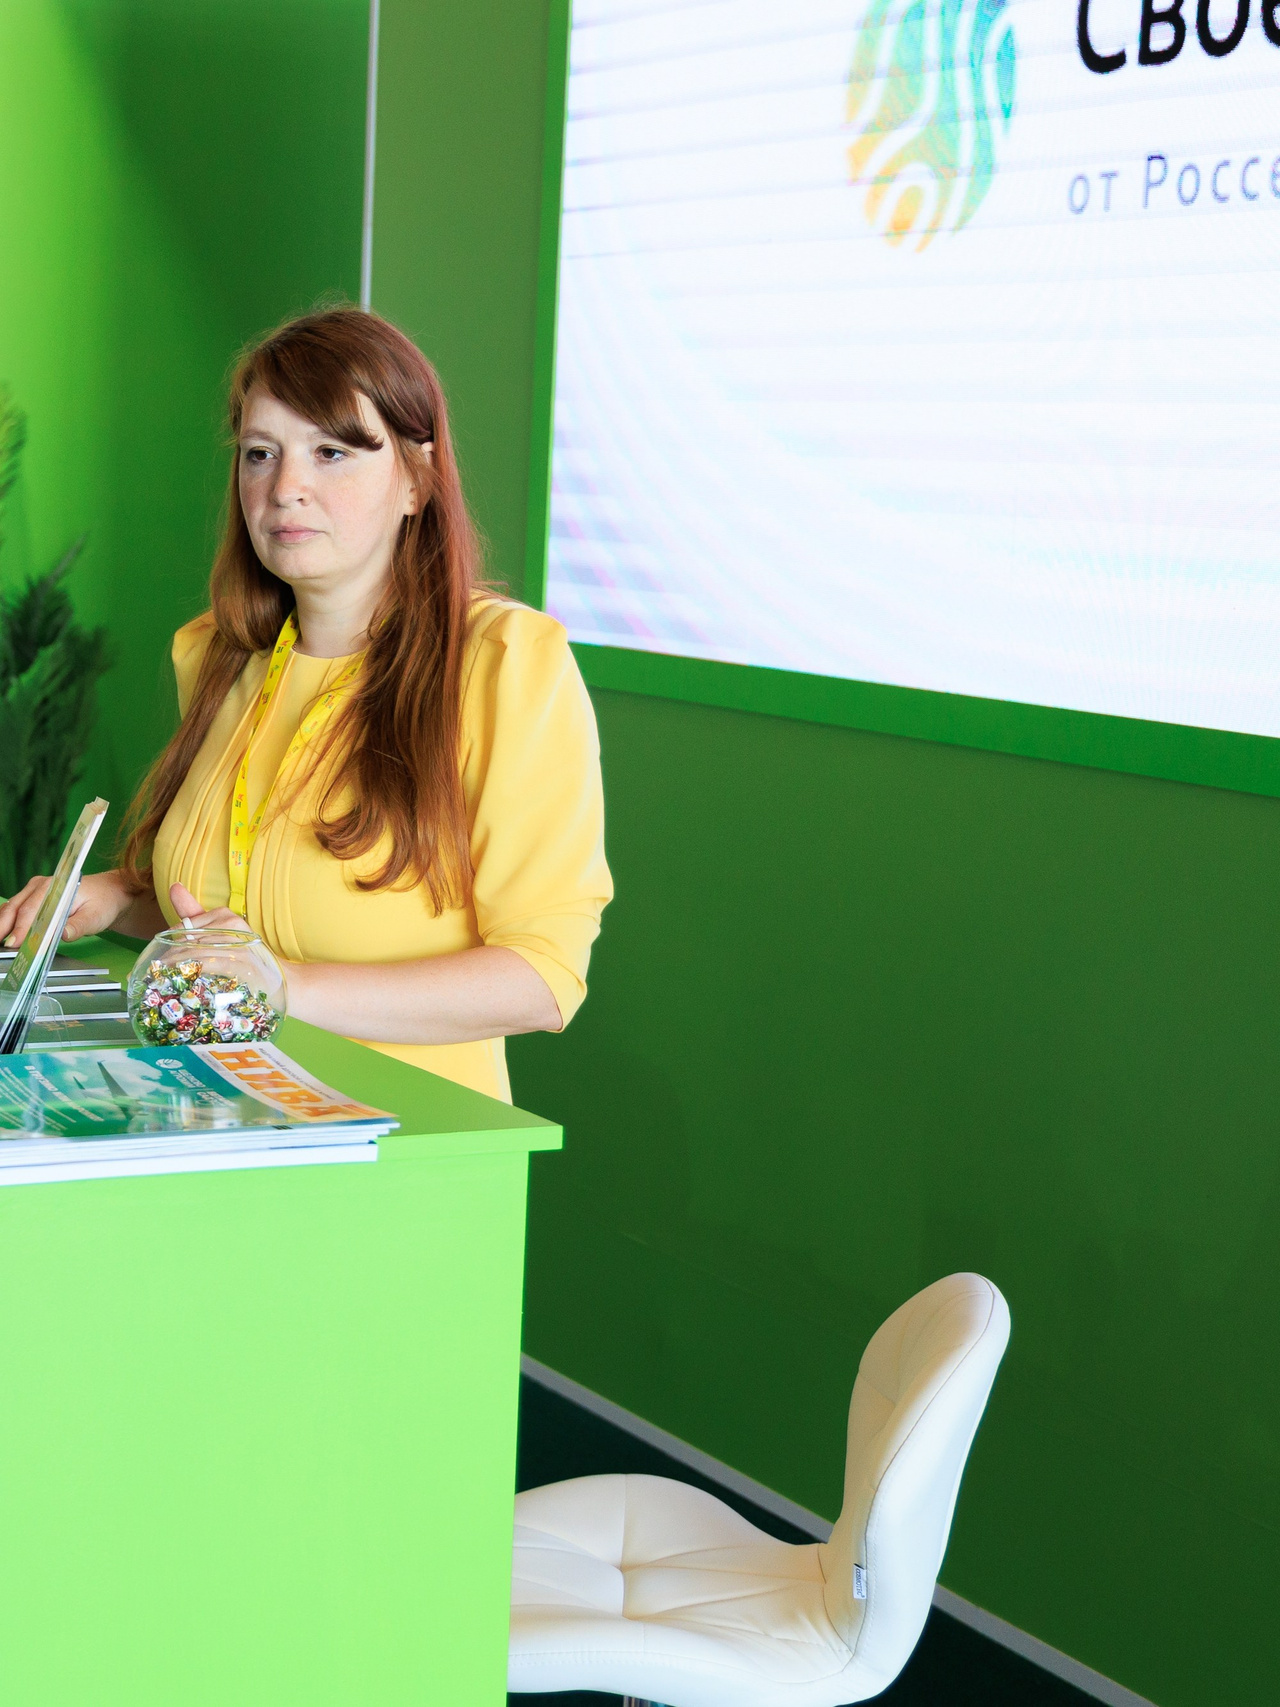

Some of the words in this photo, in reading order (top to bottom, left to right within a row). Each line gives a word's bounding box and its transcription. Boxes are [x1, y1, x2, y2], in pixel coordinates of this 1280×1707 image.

[1077, 0, 1280, 74] Сво
[1068, 171, 1118, 215] от
[208, 1048, 346, 1118] НИВА
